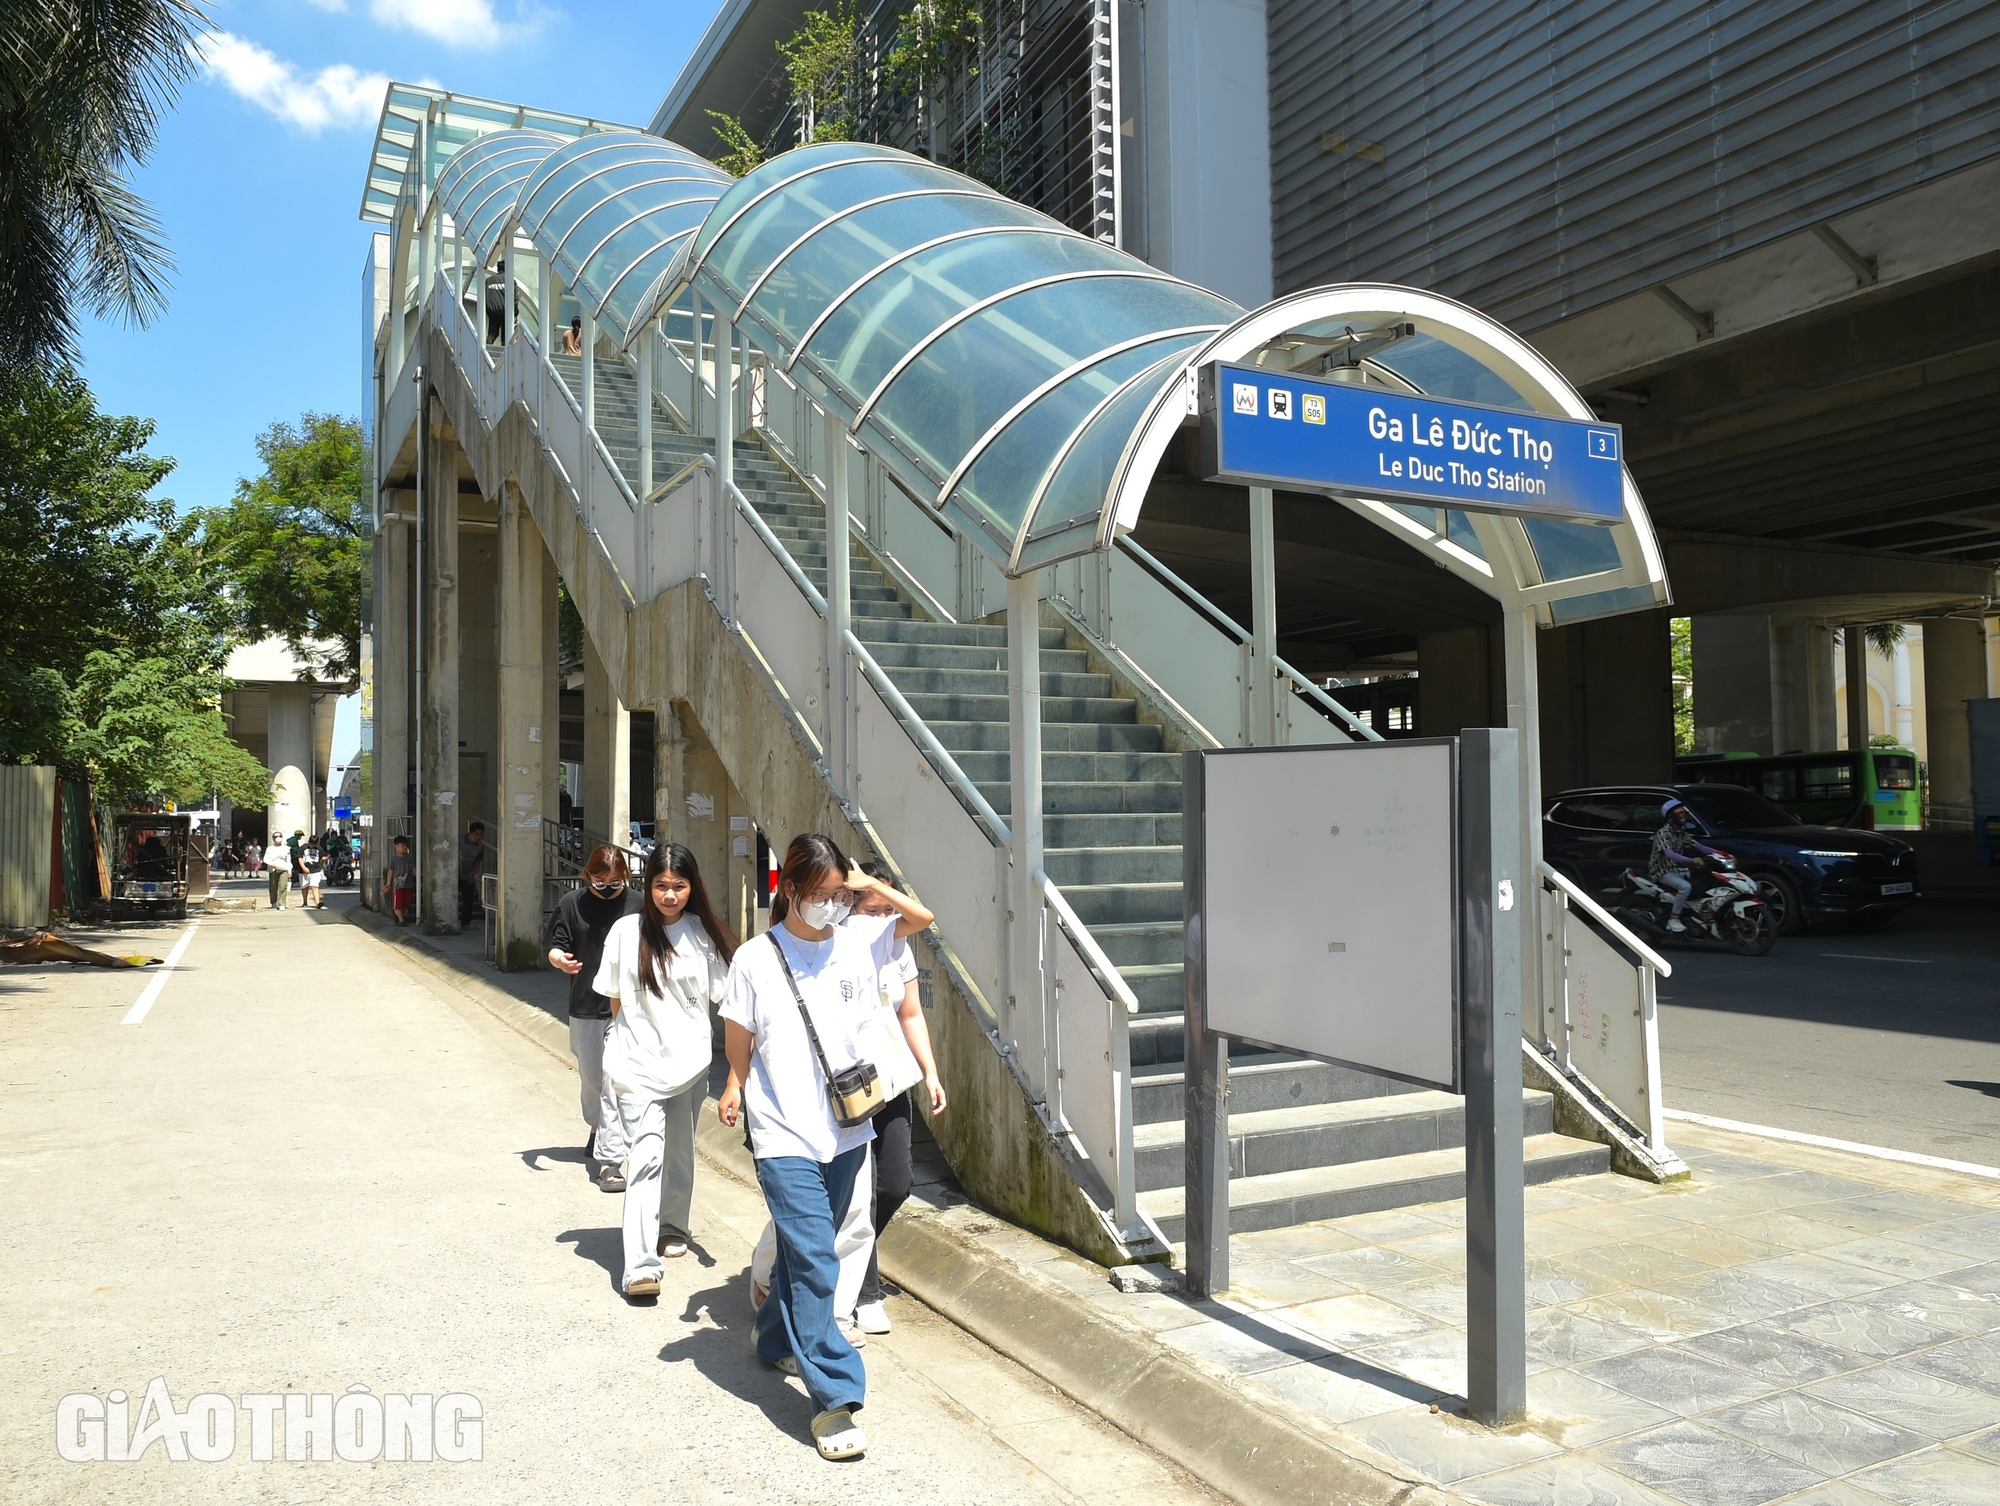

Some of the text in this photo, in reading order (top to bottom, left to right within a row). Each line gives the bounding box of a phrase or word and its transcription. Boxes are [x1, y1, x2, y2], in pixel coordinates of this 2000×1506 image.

[1307, 408, 1321, 418] S05
[1369, 407, 1553, 469] Ga Lê Đức Thọ
[1599, 439, 1606, 452] 3
[1379, 452, 1546, 495] Le Duc Tho Station
